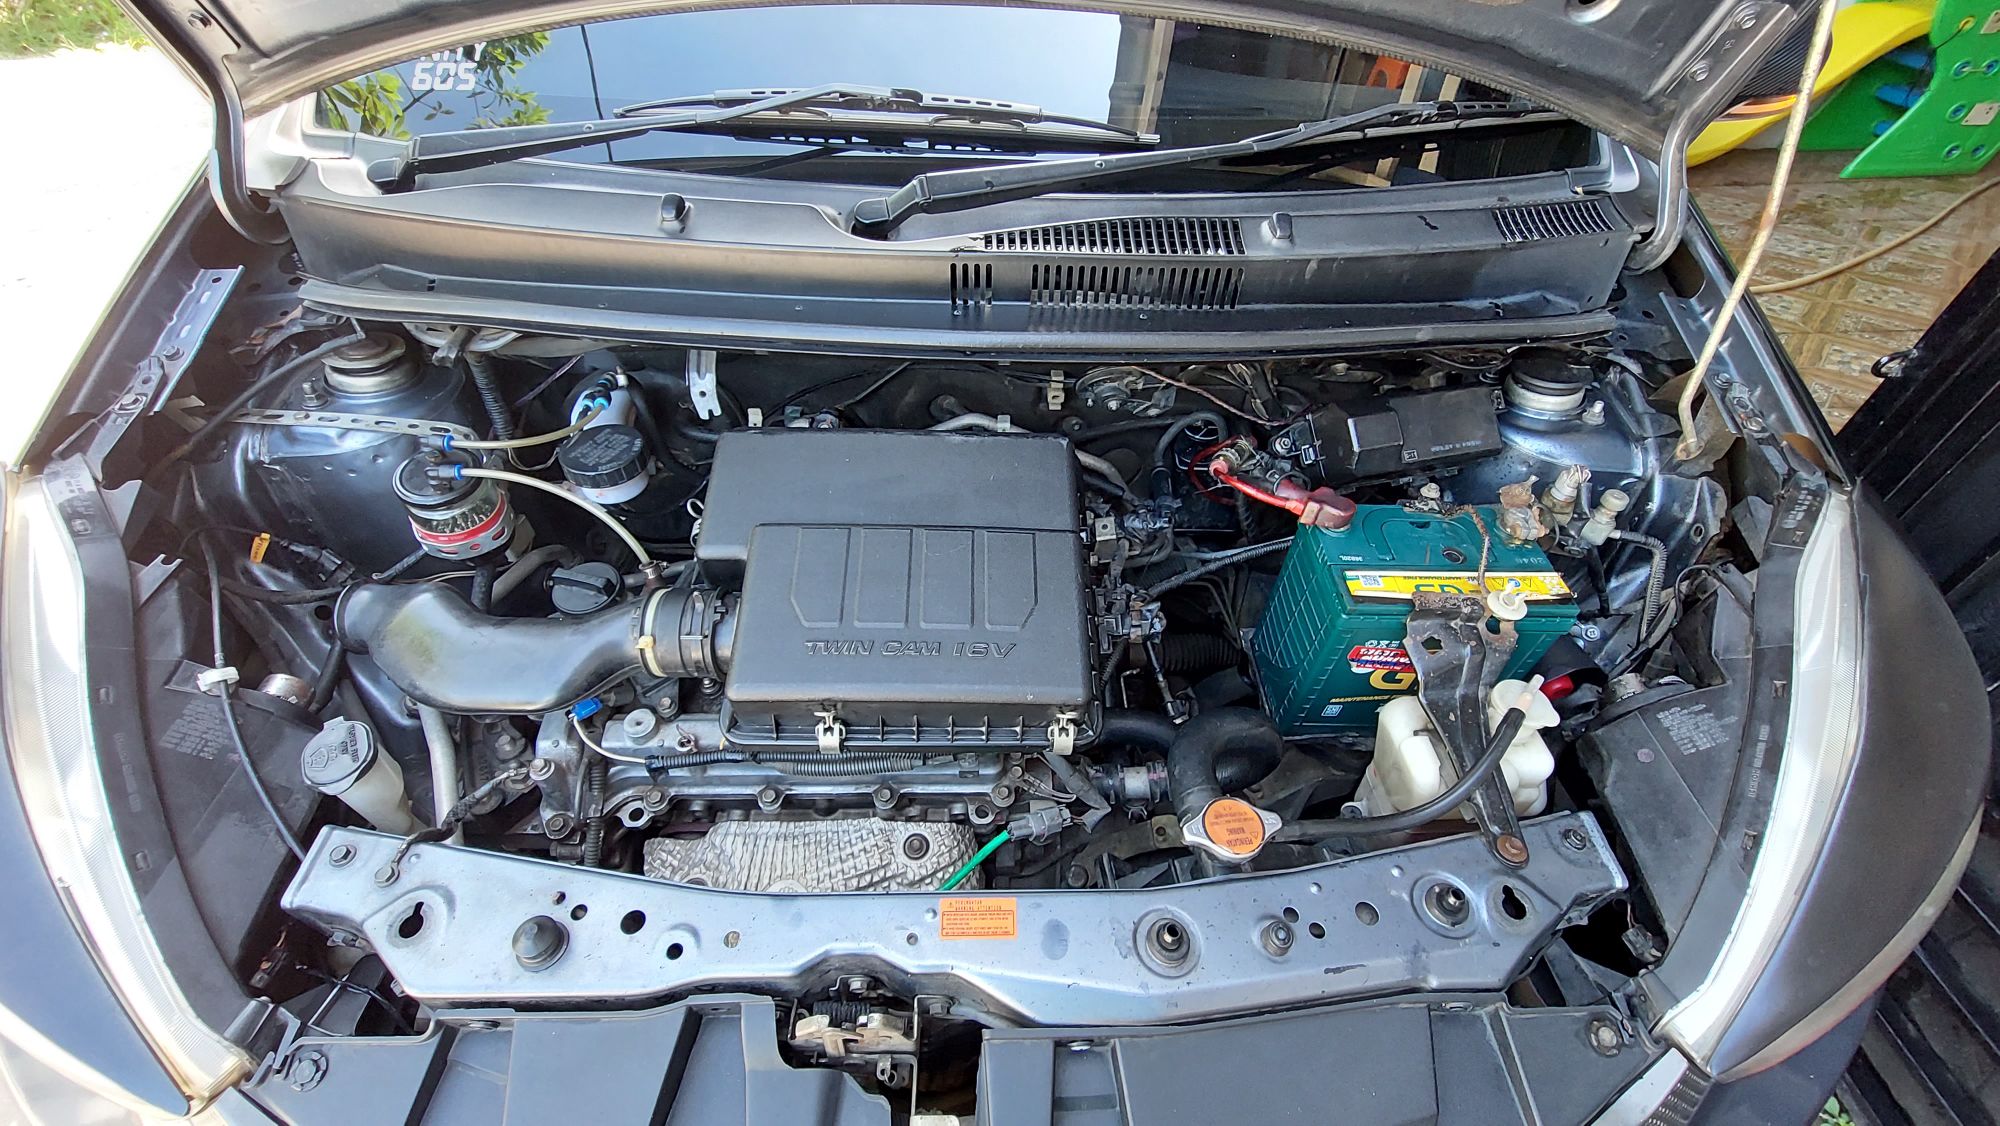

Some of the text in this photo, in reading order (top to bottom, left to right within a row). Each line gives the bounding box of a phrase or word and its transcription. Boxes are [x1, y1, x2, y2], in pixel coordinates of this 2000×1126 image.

[411, 62, 477, 91] 605
[805, 640, 1017, 658] TWIN CAM 16V
